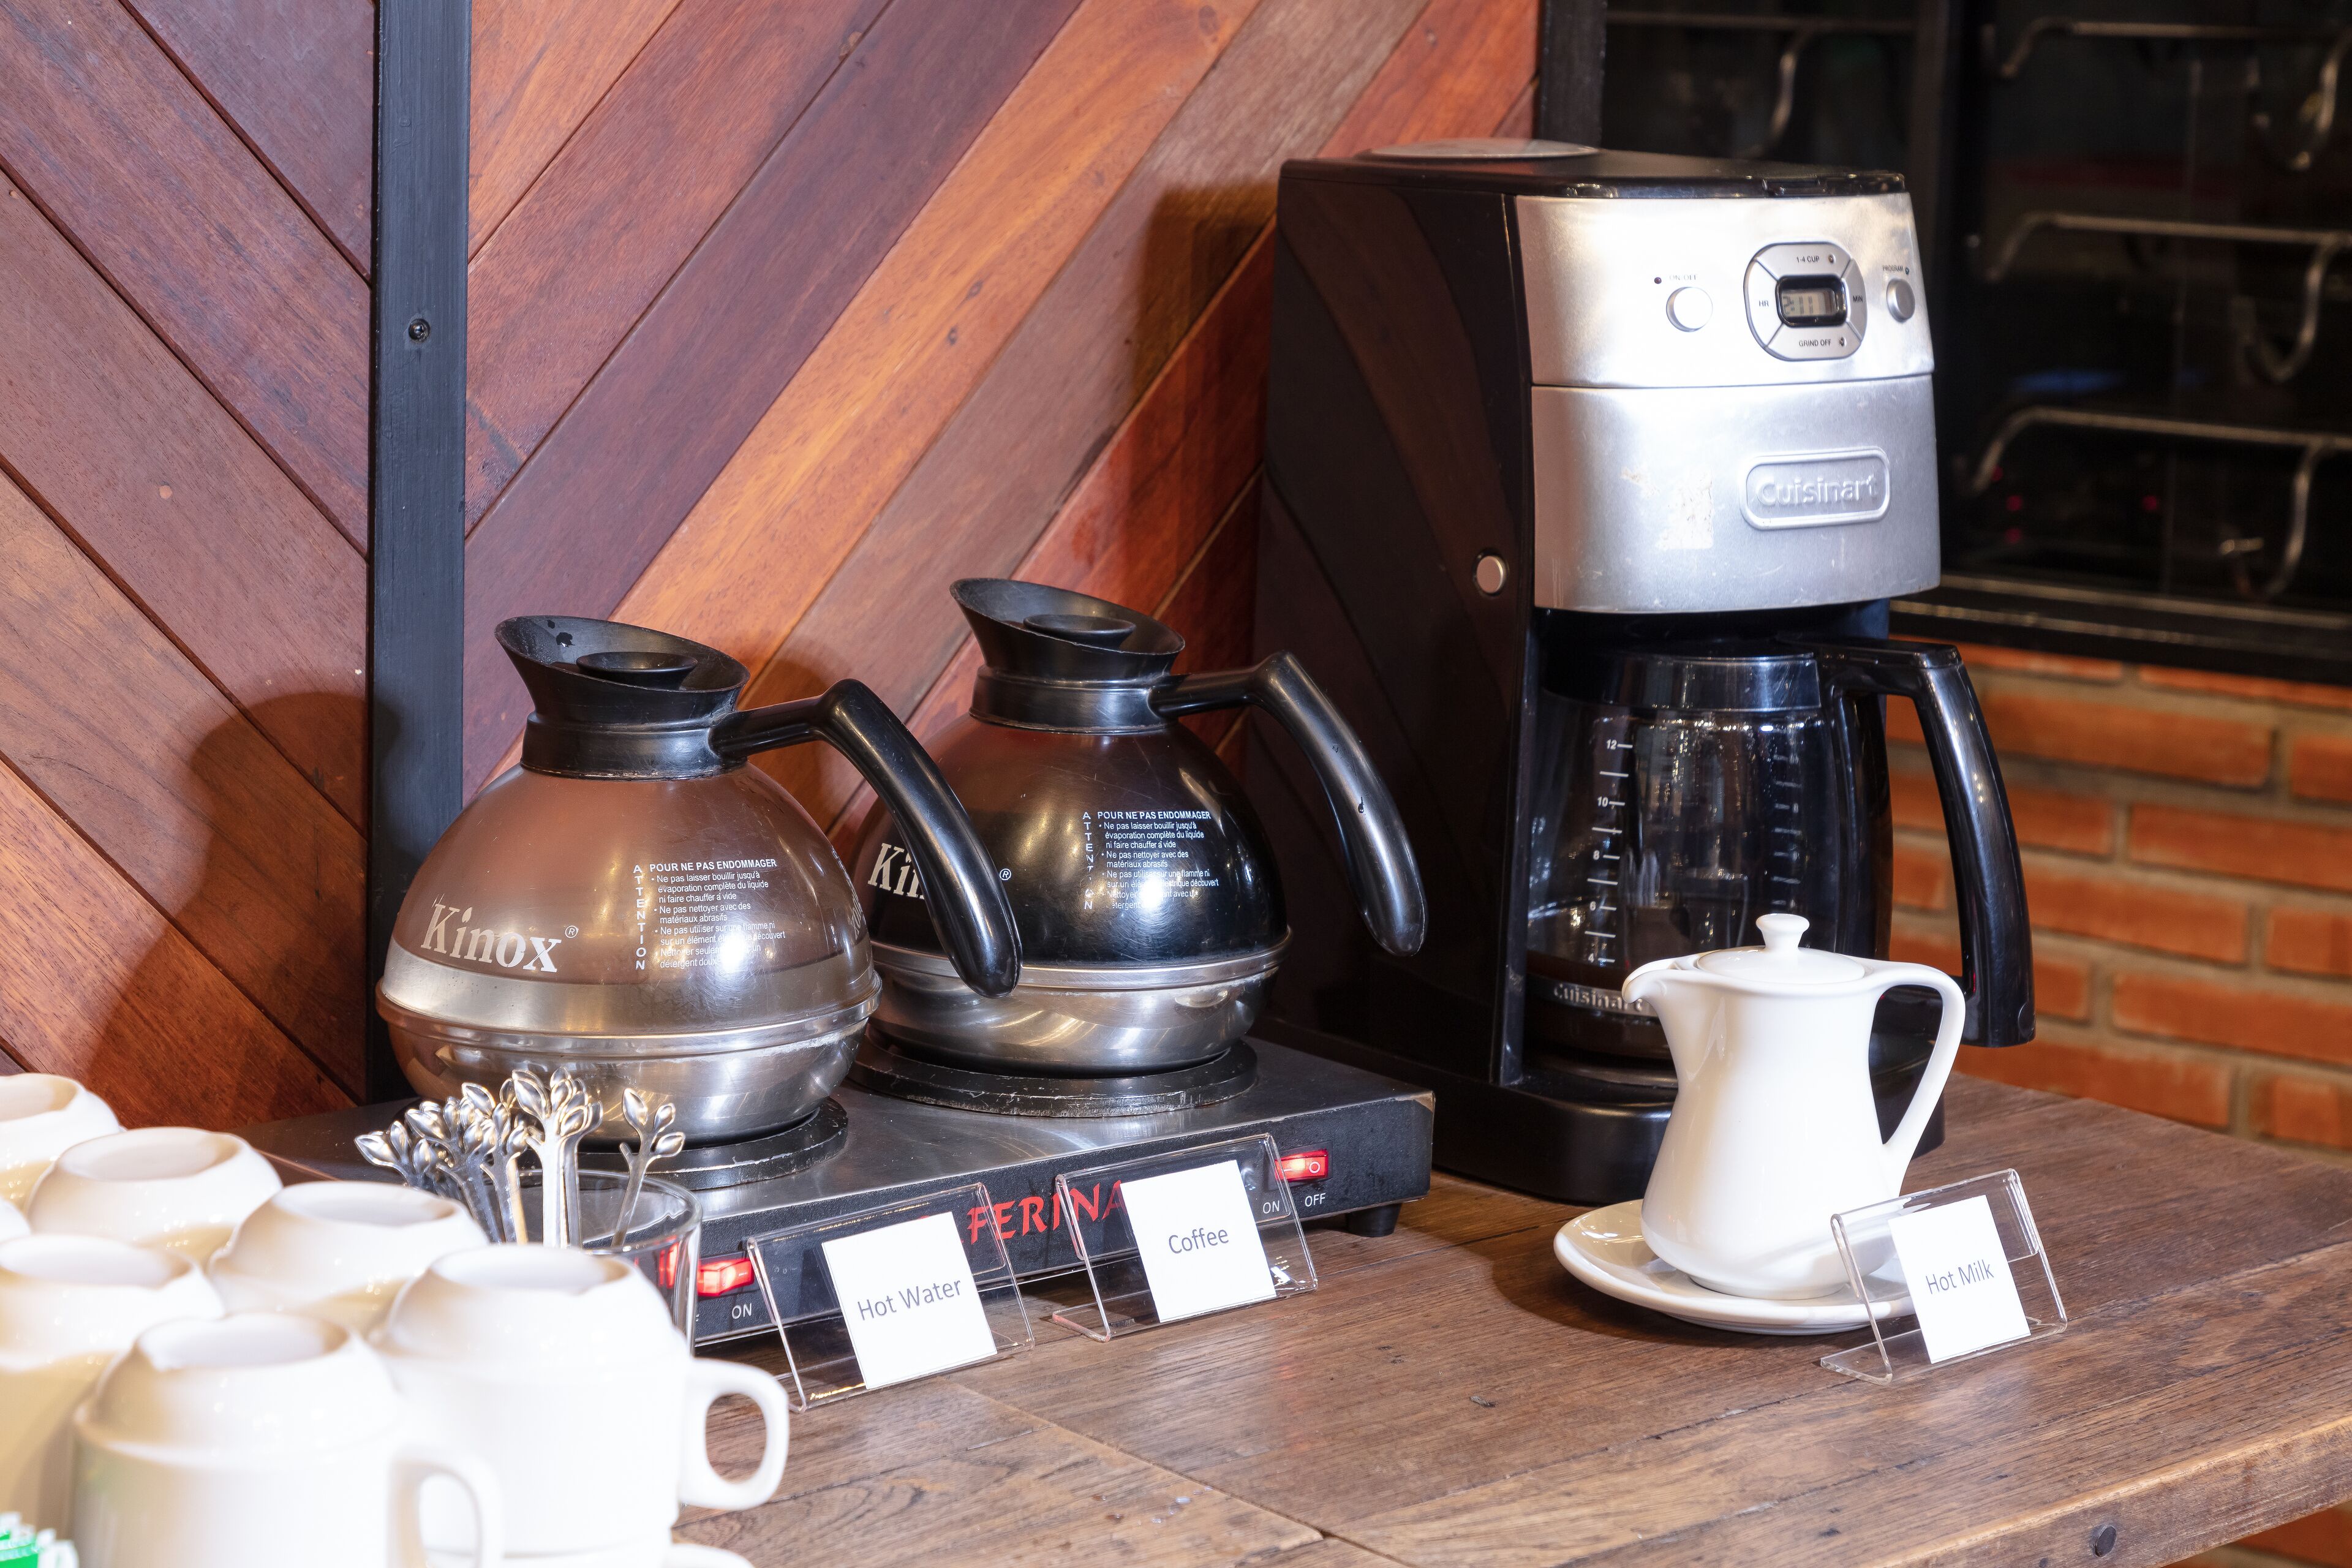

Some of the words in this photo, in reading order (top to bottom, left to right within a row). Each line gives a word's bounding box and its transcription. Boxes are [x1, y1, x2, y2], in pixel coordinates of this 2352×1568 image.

[1755, 474, 1878, 506] Cuisinart
[1606, 739, 1618, 750] 12
[1597, 796, 1608, 807] 10
[1158, 811, 1212, 820] ENDOMMAGER
[1105, 831, 1145, 840] évaporation
[1147, 831, 1175, 840] complète
[1186, 831, 1204, 840] liquide
[1133, 851, 1160, 860] nettoyer
[1593, 850, 1600, 861] 8
[649, 863, 679, 872] POUR
[680, 862, 694, 871] NE
[696, 861, 715, 870] PAS
[716, 859, 777, 870] ENDOMMAGER
[670, 876, 685, 884] pas
[686, 873, 710, 882] laisser
[712, 872, 736, 881] bouillir
[1119, 871, 1132, 880] pas
[658, 884, 703, 894] évaporation
[704, 881, 736, 892] complète
[737, 881, 746, 889] du
[747, 880, 769, 890] liquide
[1190, 878, 1219, 887] découvert
[659, 895, 666, 903] ni
[667, 895, 684, 903] faire
[685, 894, 715, 902] chauffer
[673, 907, 687, 915] pas
[688, 905, 718, 913] nettoyer
[738, 902, 751, 910] des
[1589, 901, 1596, 911] 6
[660, 915, 698, 924] matériaux
[699, 913, 728, 922] abrasifs
[673, 927, 688, 937] pas
[689, 924, 714, 934] utiliser
[742, 922, 768, 931] flamme
[769, 921, 775, 929] ni
[421, 903, 562, 973] Kinox
[687, 935, 716, 944] élément
[753, 930, 786, 941] découvert
[1588, 952, 1595, 963] 4
[660, 957, 698, 970] détergent
[1262, 1200, 1280, 1215] ON
[1304, 1193, 1327, 1208] OFF
[1168, 1227, 1230, 1254] Coffee
[1925, 1270, 1958, 1295] Hot
[1958, 1259, 1995, 1286] Milk
[858, 1295, 897, 1321] Hot
[898, 1279, 962, 1310] Water
[731, 1302, 753, 1320] ON
